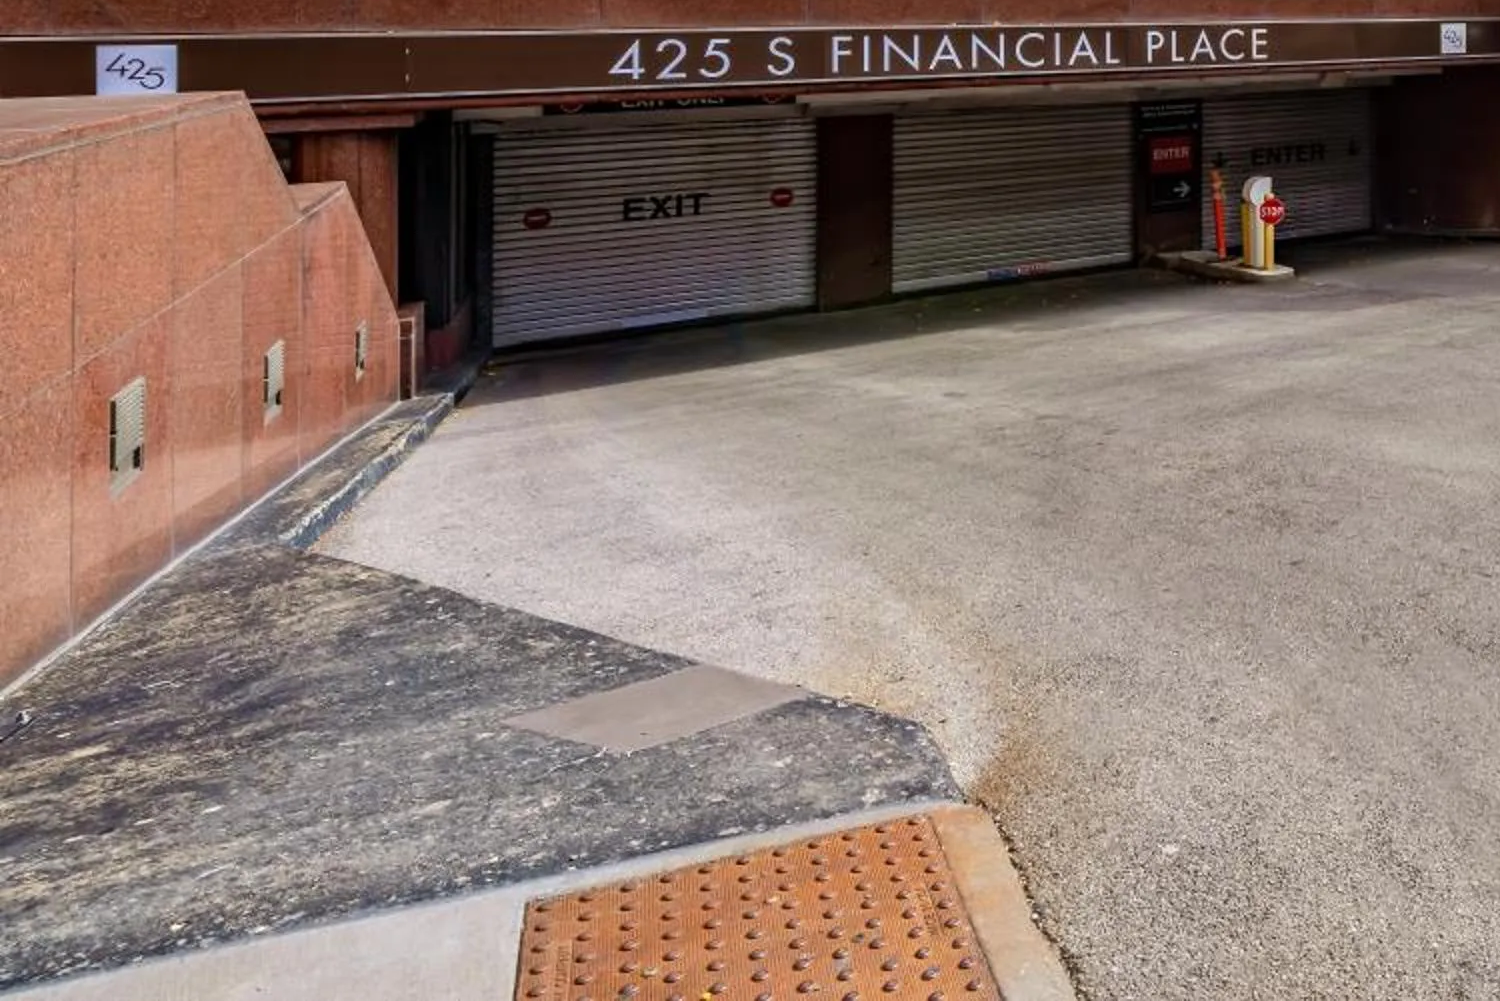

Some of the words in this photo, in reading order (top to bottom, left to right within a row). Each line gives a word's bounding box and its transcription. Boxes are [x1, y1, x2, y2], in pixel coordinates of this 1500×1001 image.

[608, 38, 731, 80] 425
[767, 36, 796, 76] S
[831, 30, 1121, 73] FINANCIAL
[1146, 28, 1269, 64] PLACE
[105, 52, 165, 90] 425
[1152, 145, 1191, 161] ENTER
[1250, 143, 1326, 166] ENTER
[622, 193, 712, 221] EXIT
[1261, 205, 1285, 218] STOP
